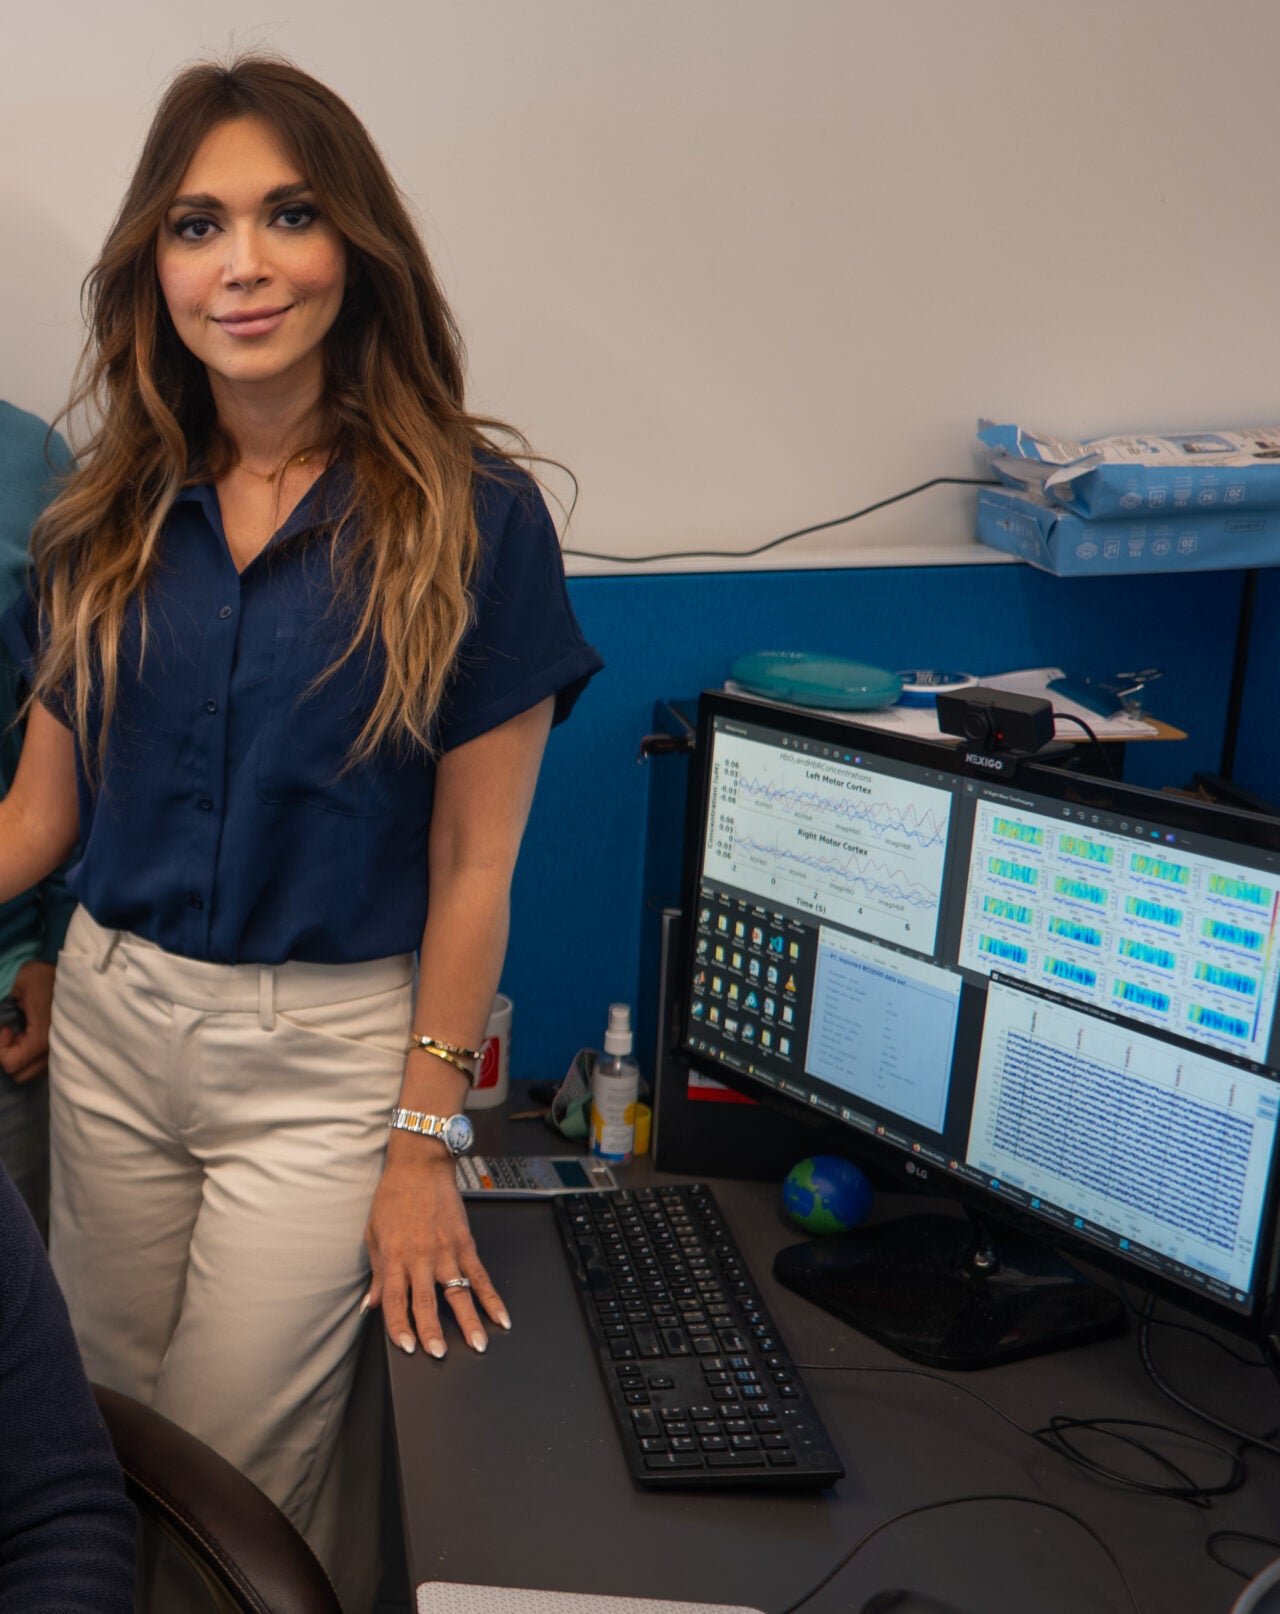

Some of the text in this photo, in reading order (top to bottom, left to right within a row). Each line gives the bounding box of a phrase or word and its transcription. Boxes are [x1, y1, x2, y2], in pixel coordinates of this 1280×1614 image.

[724, 759, 739, 769] 0.06
[964, 752, 1003, 770] NEXIGO
[806, 771, 872, 795] Left Motor Cortex
[798, 828, 868, 856] Right Motor Cortex
[796, 897, 826, 914] Time (S)
[857, 907, 863, 915] 4
[904, 923, 910, 931] 6
[916, 1168, 928, 1180] LG
